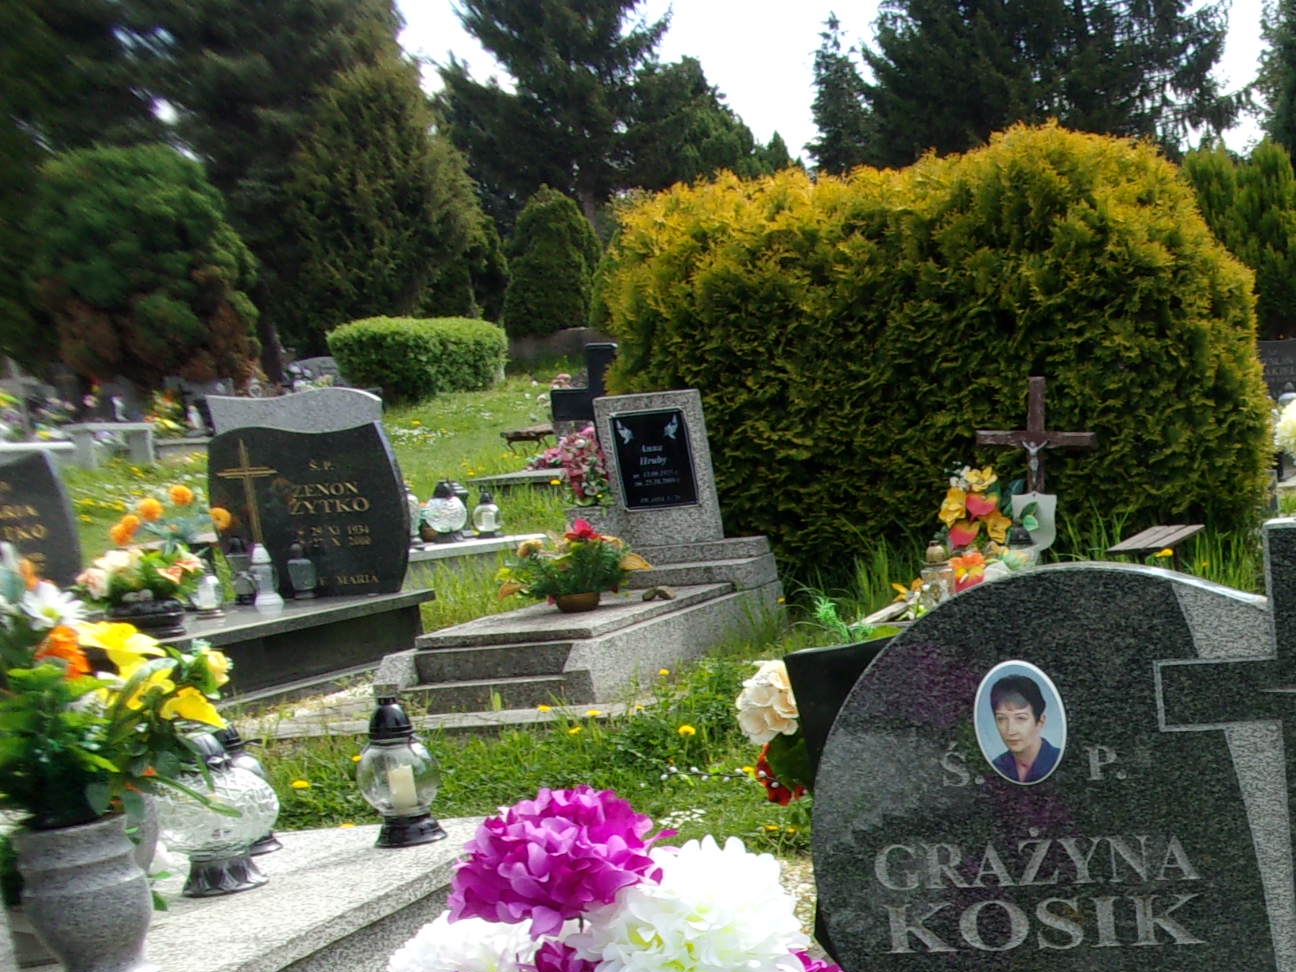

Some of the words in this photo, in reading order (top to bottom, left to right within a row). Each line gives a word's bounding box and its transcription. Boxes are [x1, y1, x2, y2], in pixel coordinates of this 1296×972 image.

[291, 481, 360, 497] ZENON
[1085, 744, 1128, 781] P.
[874, 826, 1202, 891] GRAŻYNA
[880, 892, 1207, 955] KOSIK
